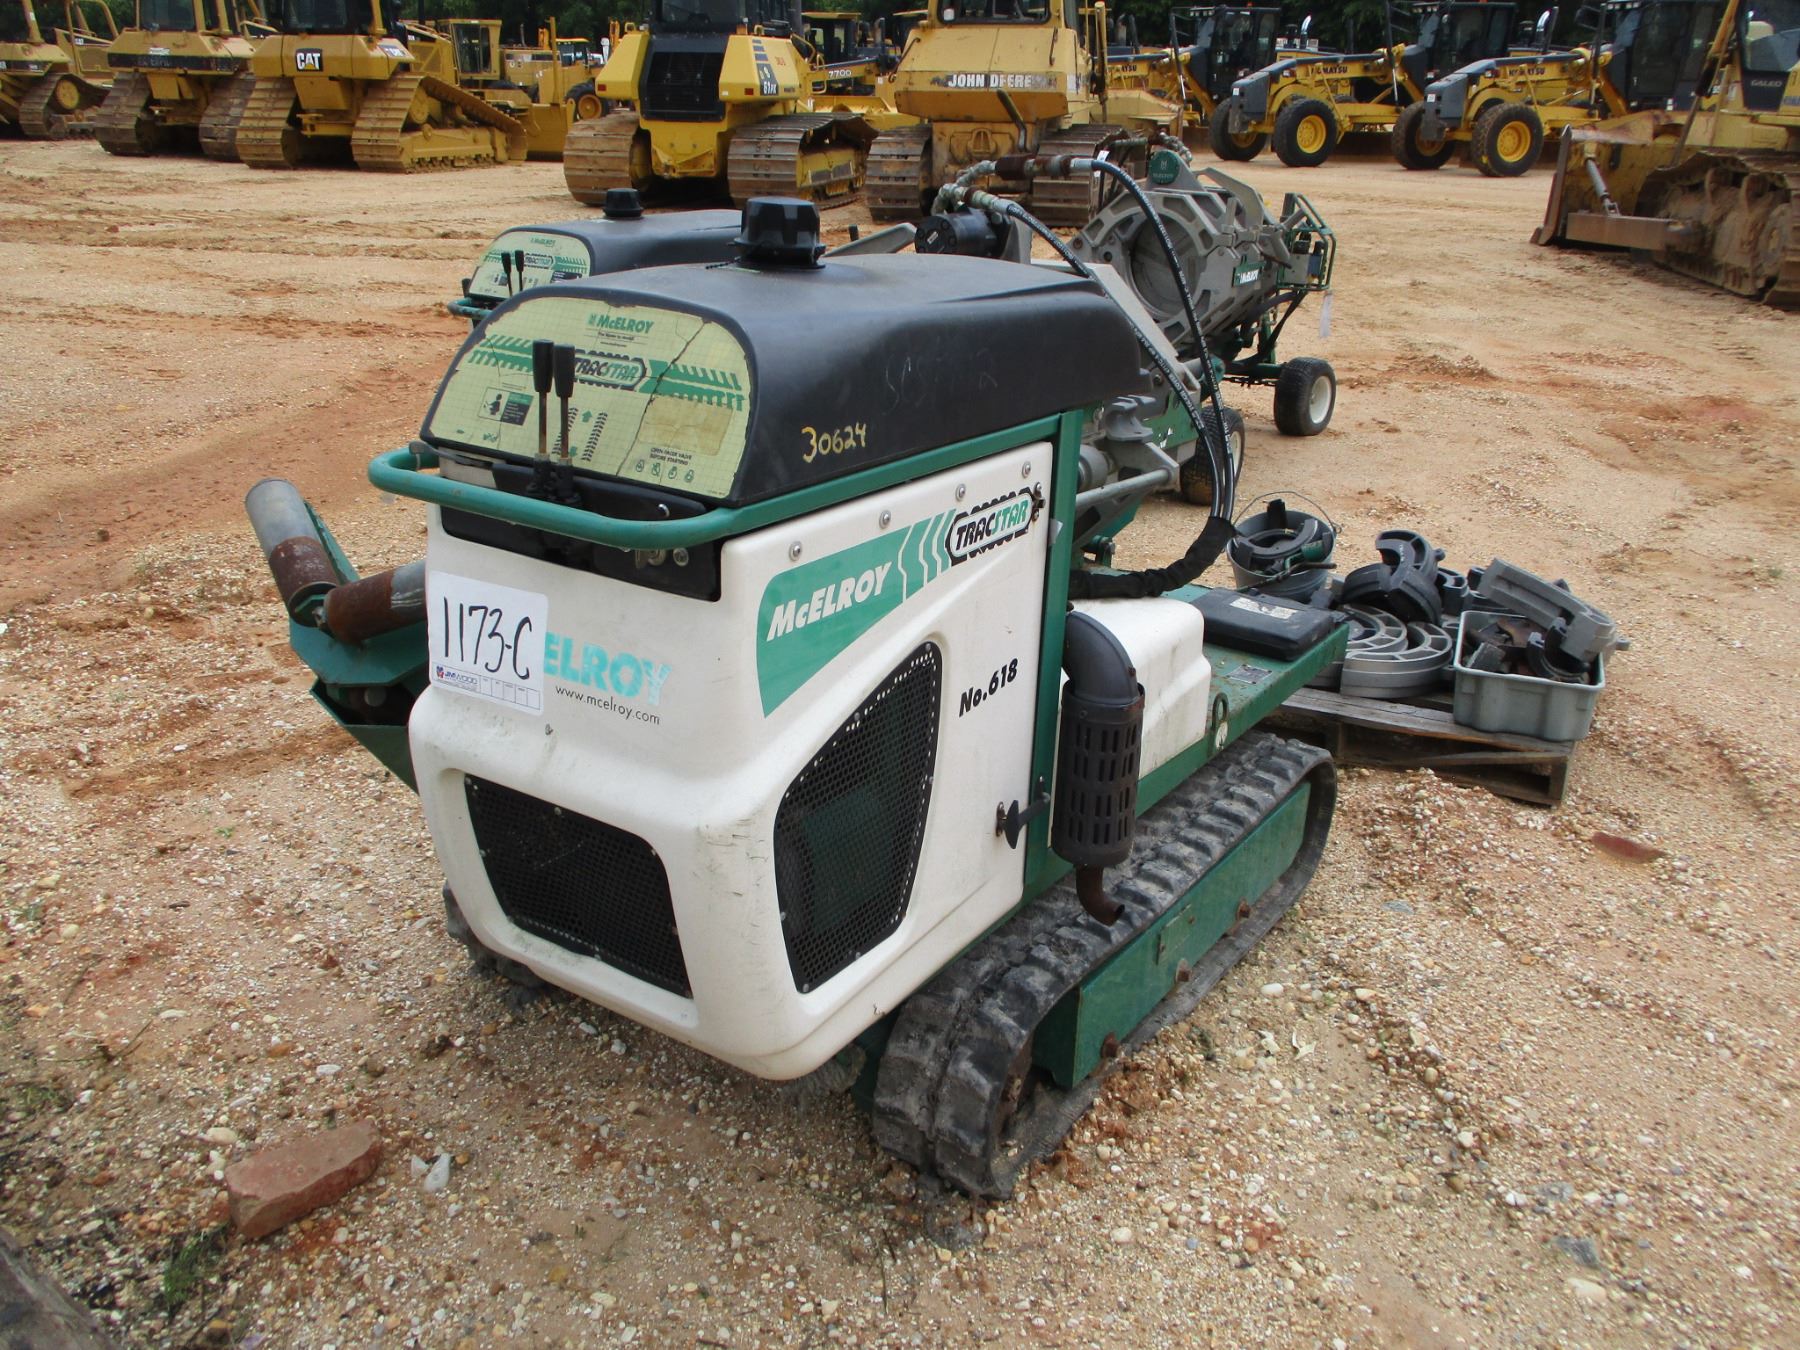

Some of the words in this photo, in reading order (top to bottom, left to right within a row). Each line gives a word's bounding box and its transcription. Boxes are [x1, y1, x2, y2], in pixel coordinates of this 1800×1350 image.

[296, 52, 321, 70] CAT
[948, 74, 985, 88] JOHN
[596, 313, 655, 334] McELROY
[801, 422, 867, 463] 30624
[955, 499, 1030, 551] TRACSTAR
[766, 561, 893, 642] McELROY
[443, 596, 533, 680] 1173-C
[543, 631, 672, 706] ELROY
[958, 657, 1020, 718] No.618
[555, 684, 661, 726] www.mcelroy.com
